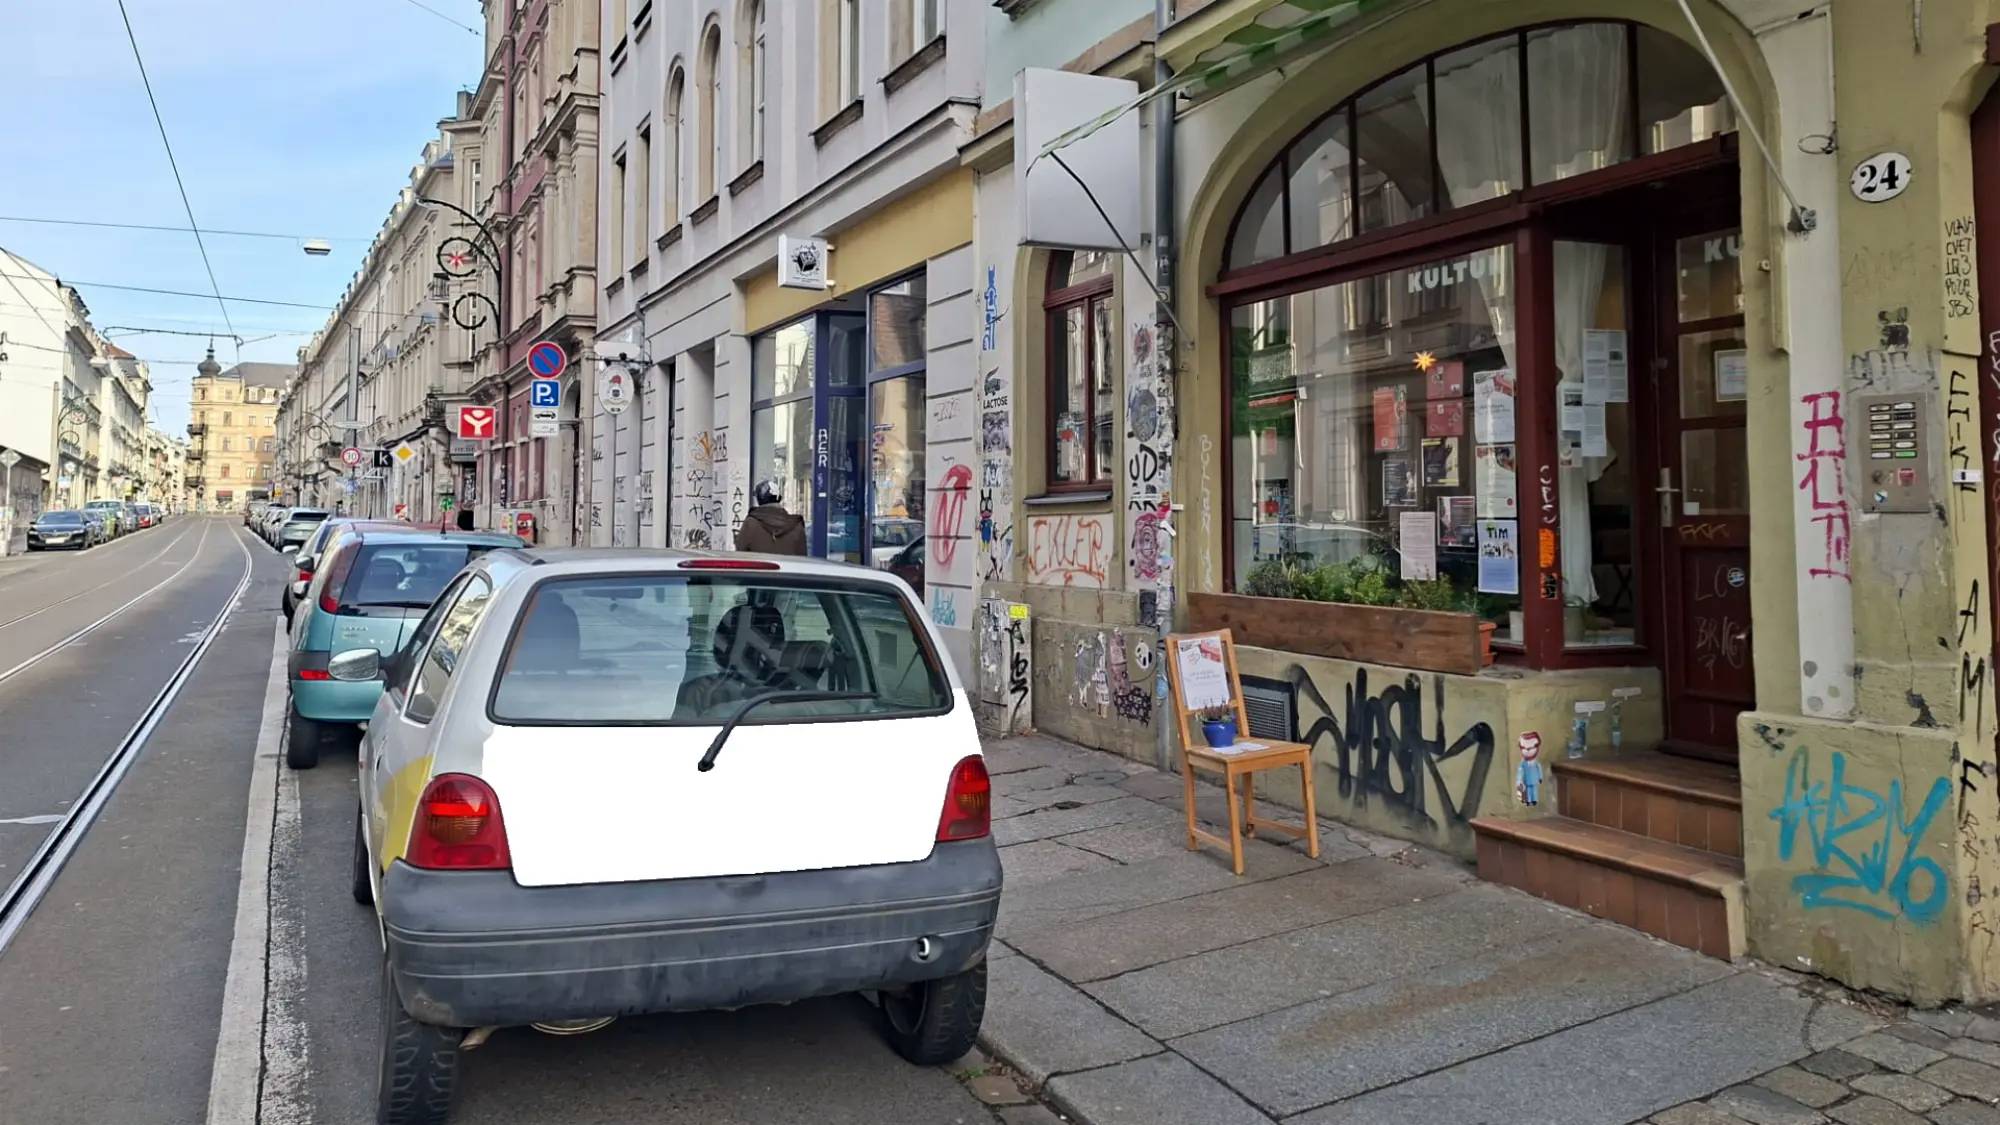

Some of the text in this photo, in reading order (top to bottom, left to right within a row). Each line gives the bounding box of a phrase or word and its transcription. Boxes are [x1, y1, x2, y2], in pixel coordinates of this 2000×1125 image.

[1860, 160, 1898, 195] 24
[536, 383, 552, 403] P
[983, 396, 1008, 409] LACTOSE
